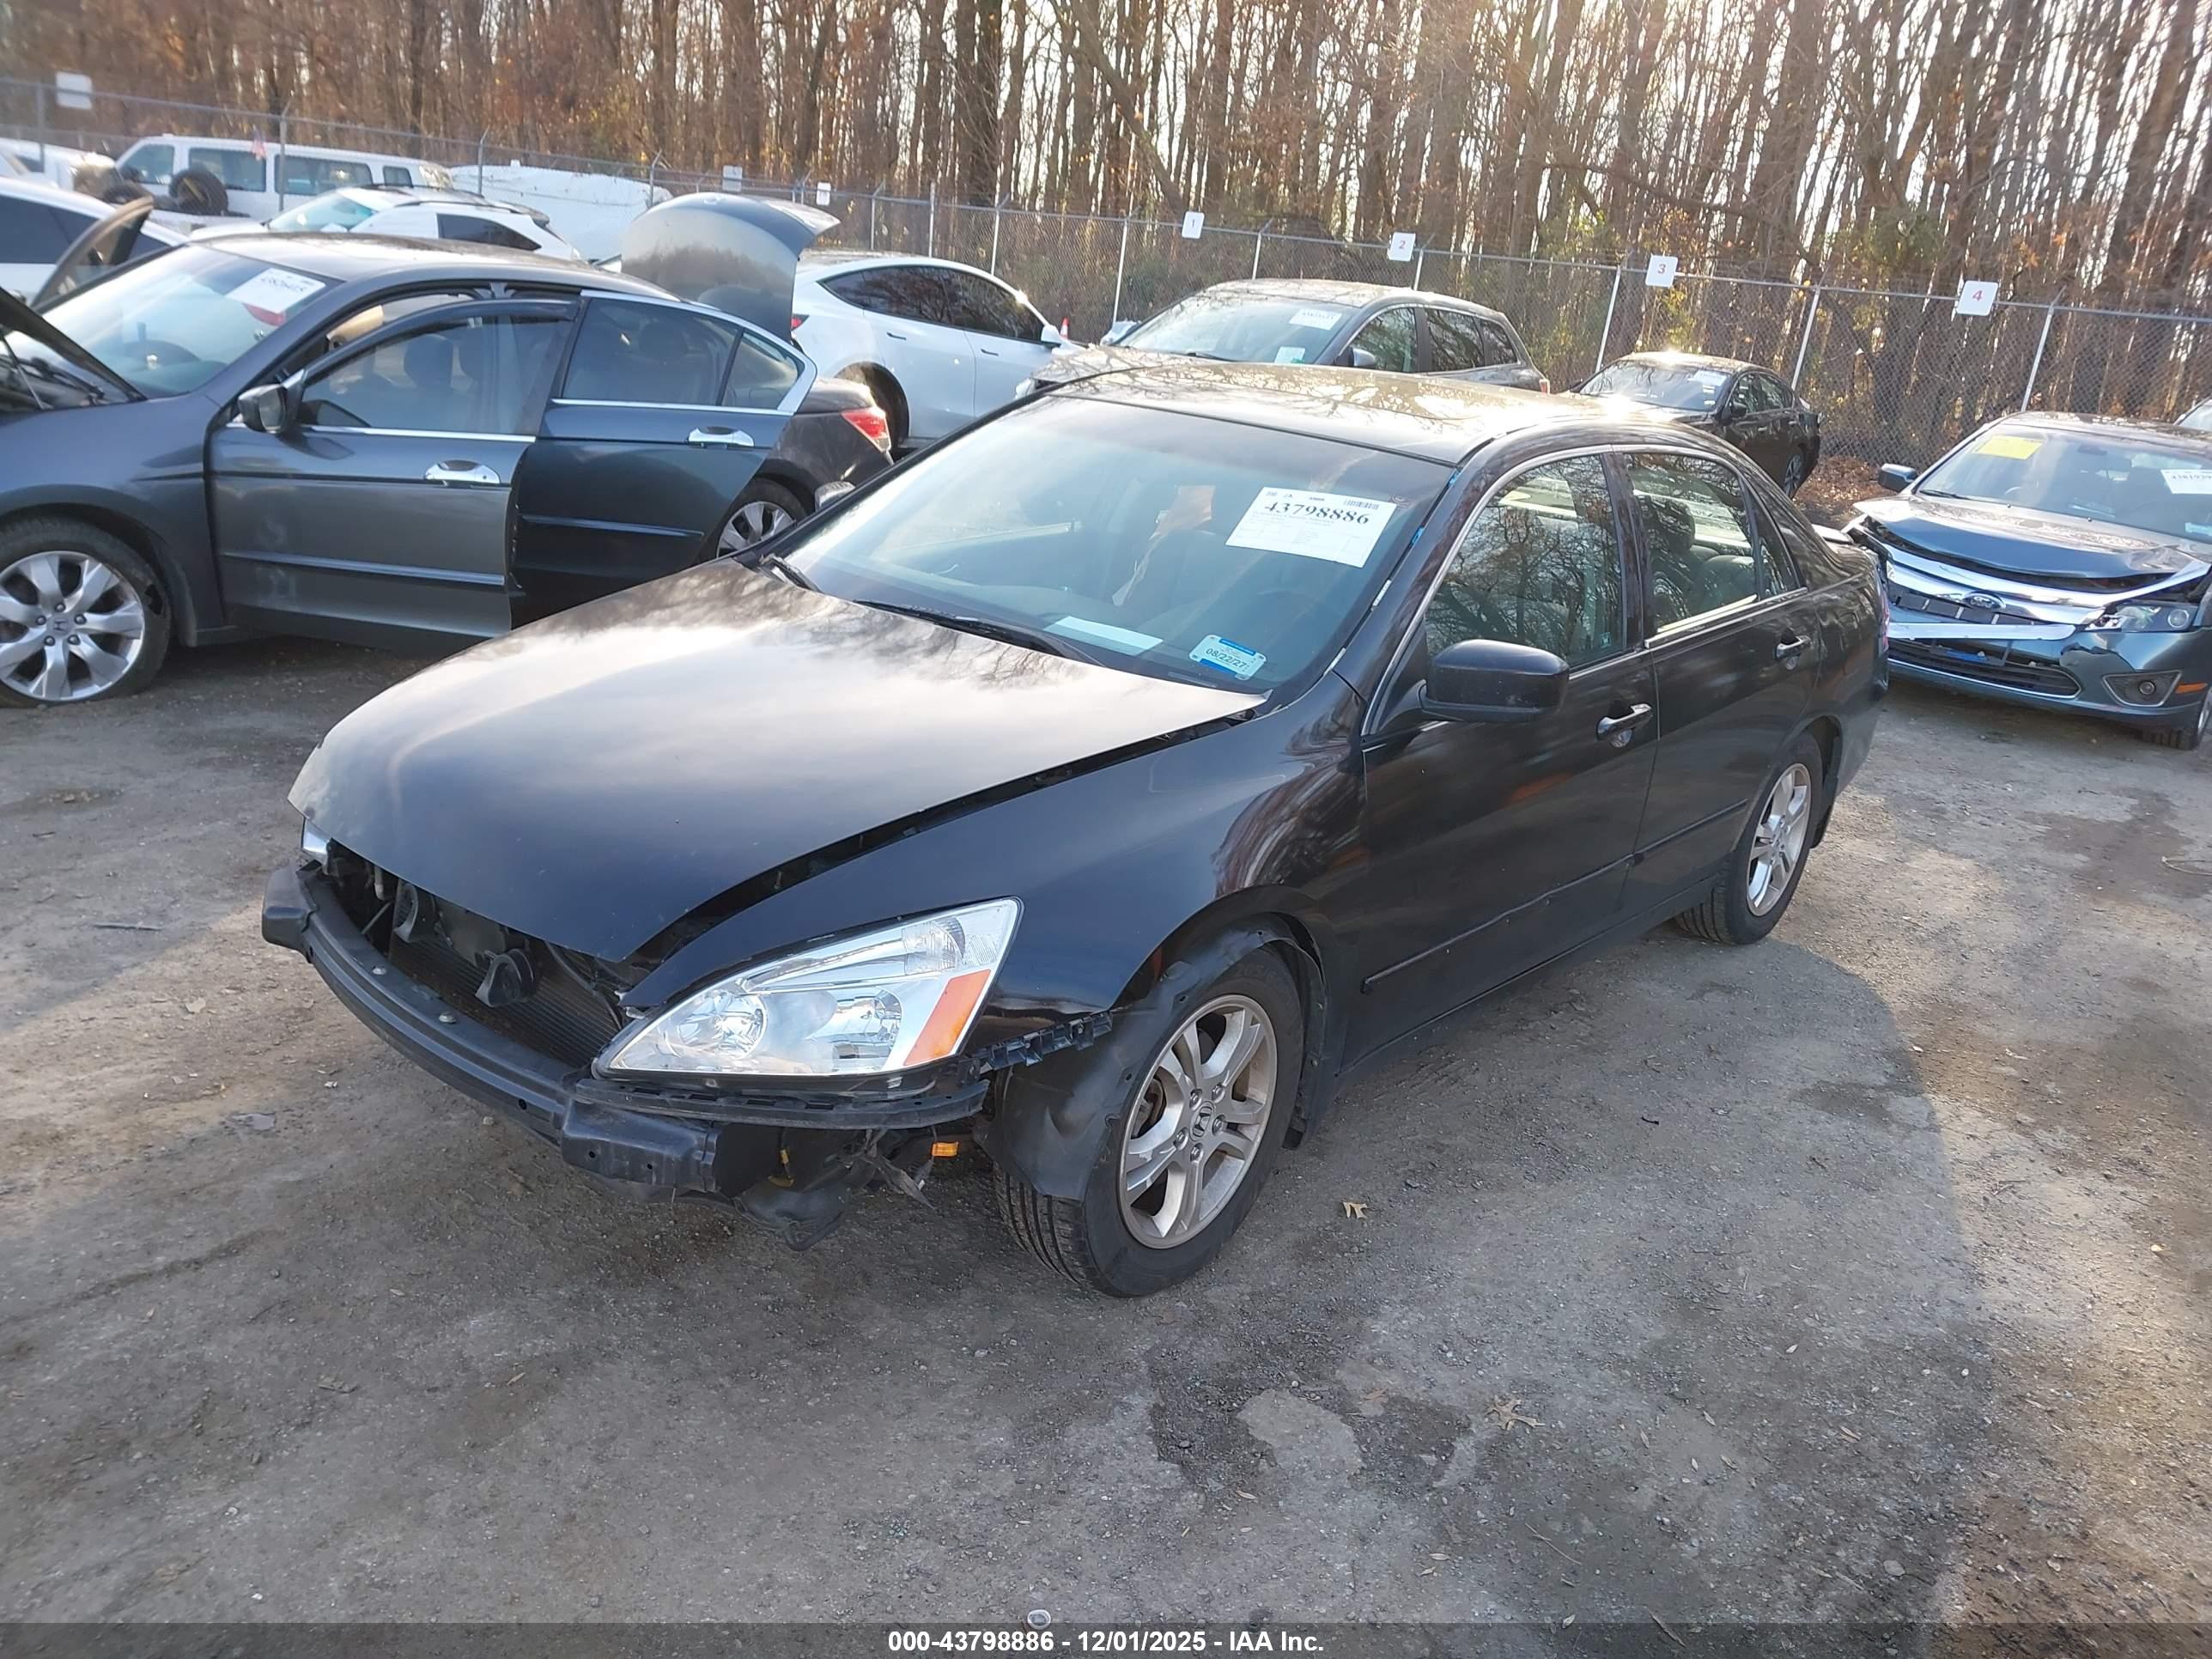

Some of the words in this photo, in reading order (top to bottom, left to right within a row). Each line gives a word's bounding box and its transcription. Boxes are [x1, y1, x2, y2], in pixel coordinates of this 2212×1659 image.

[1398, 240, 1407, 250] 2
[1657, 263, 1667, 275] 3
[1972, 289, 1983, 301] 4
[1264, 501, 1371, 525] 43798886
[1205, 647, 1248, 669] 08/22/27
